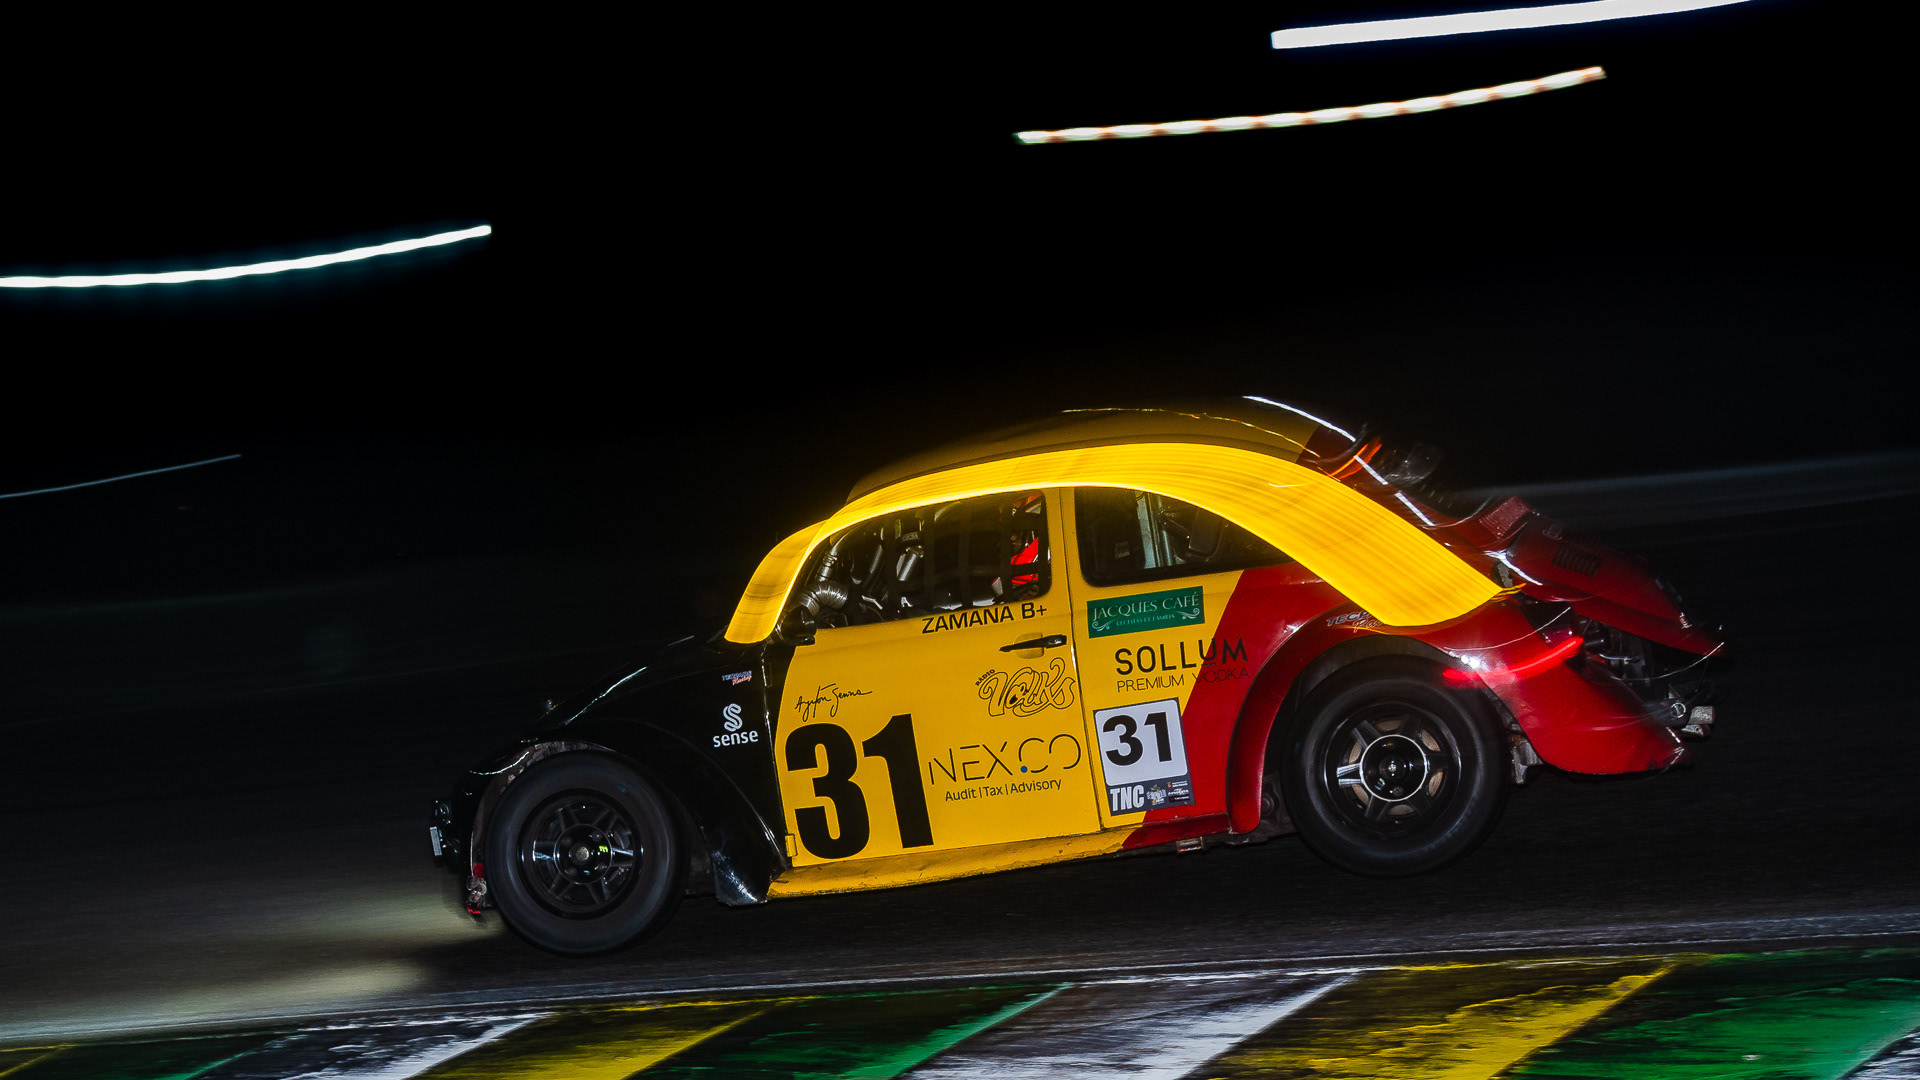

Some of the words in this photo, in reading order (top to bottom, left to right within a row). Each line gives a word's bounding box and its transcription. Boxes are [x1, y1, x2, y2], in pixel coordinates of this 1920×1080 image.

[922, 605, 1015, 634] ZAMANA
[1021, 602, 1047, 620] B+
[1092, 600, 1158, 622] JACQUES
[1162, 591, 1200, 610] CAFÉ
[1115, 636, 1248, 676] SOLLUM
[1117, 674, 1185, 693] PREMIUM
[1192, 667, 1251, 684] VODKA
[712, 730, 759, 748] sense
[1102, 711, 1173, 766] 31
[785, 713, 935, 859] 31
[945, 788, 977, 802] Audit
[983, 785, 1004, 797] Tax
[1010, 779, 1062, 794] Advisory
[1110, 784, 1145, 812] TNC
